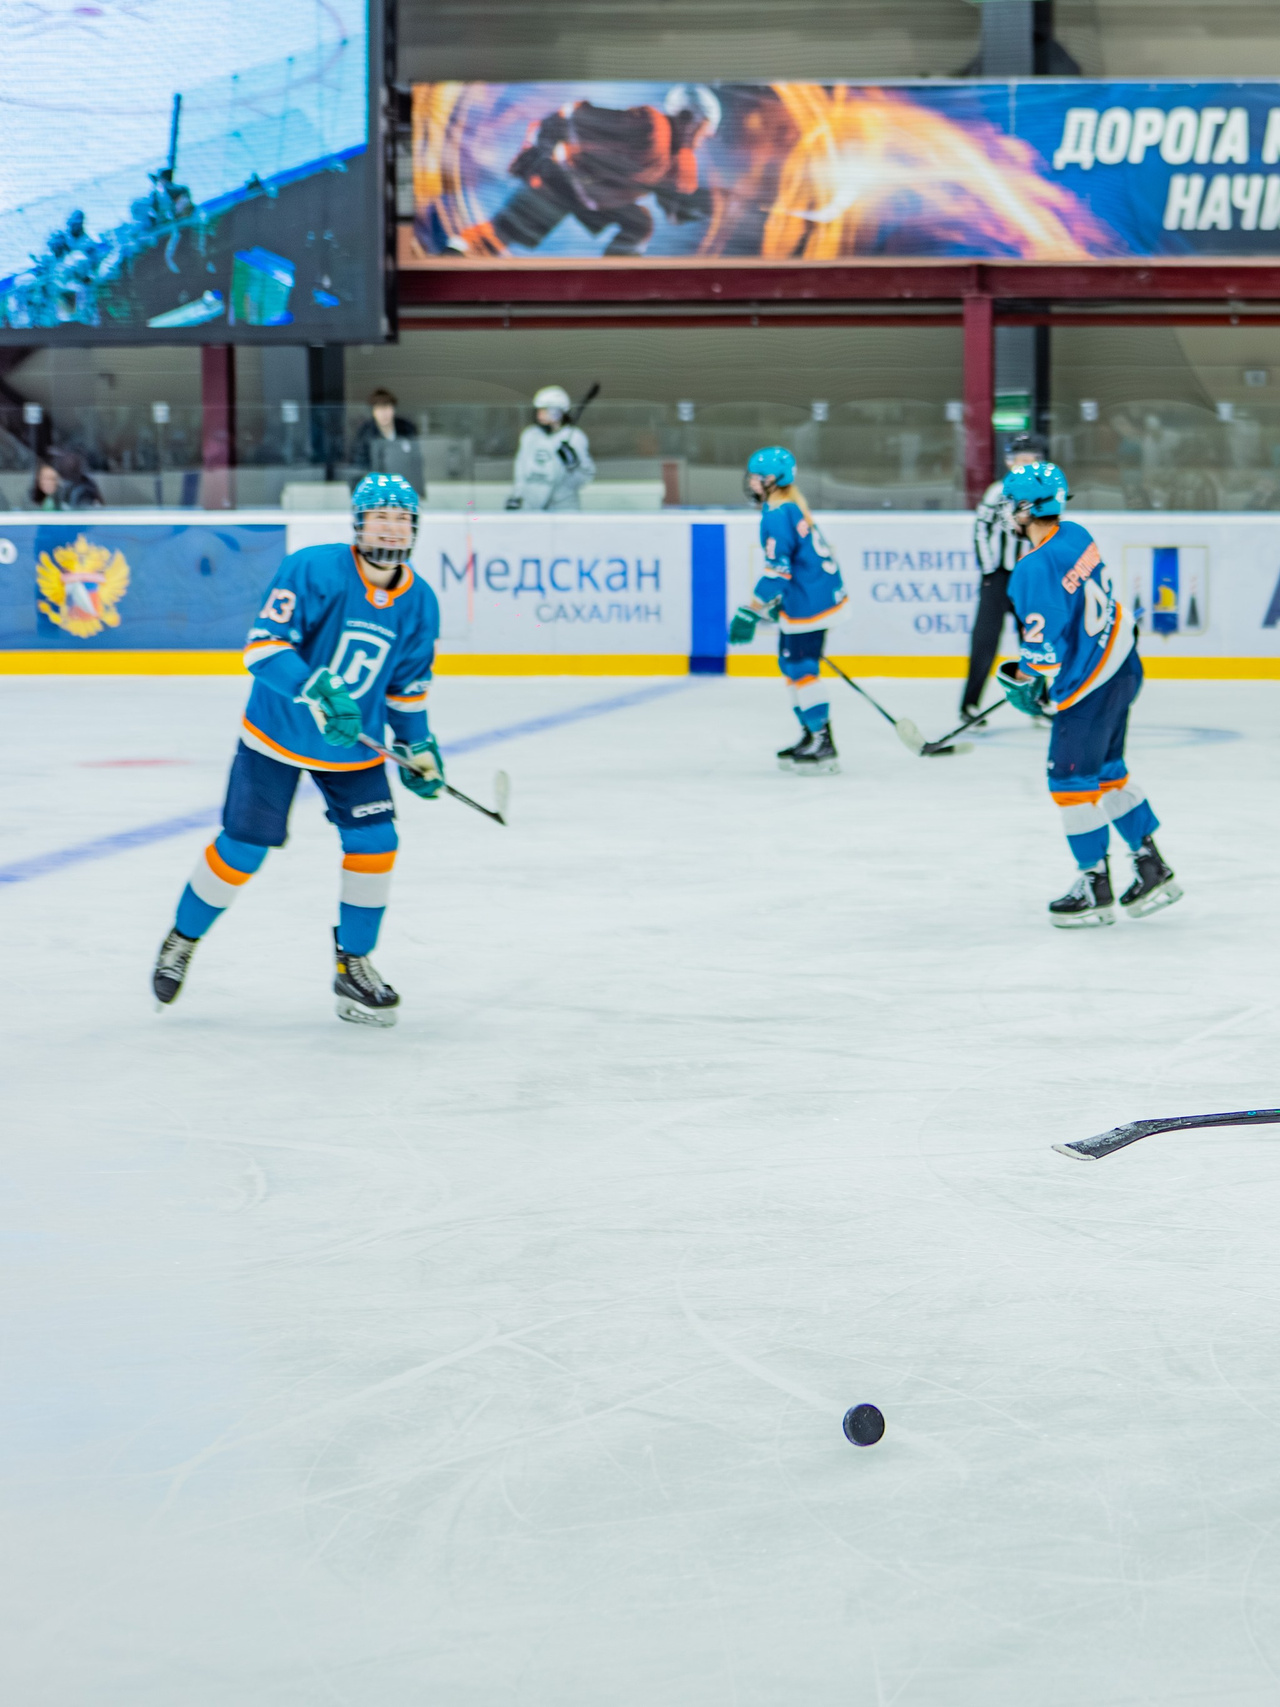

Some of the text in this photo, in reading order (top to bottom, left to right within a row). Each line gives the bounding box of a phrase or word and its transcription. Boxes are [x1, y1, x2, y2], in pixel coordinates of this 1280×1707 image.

[1053, 106, 1250, 170] ДОРОГА
[440, 551, 661, 598] Медскан
[862, 550, 980, 571] ПРАВИТ
[535, 602, 662, 624] САХАЛИН
